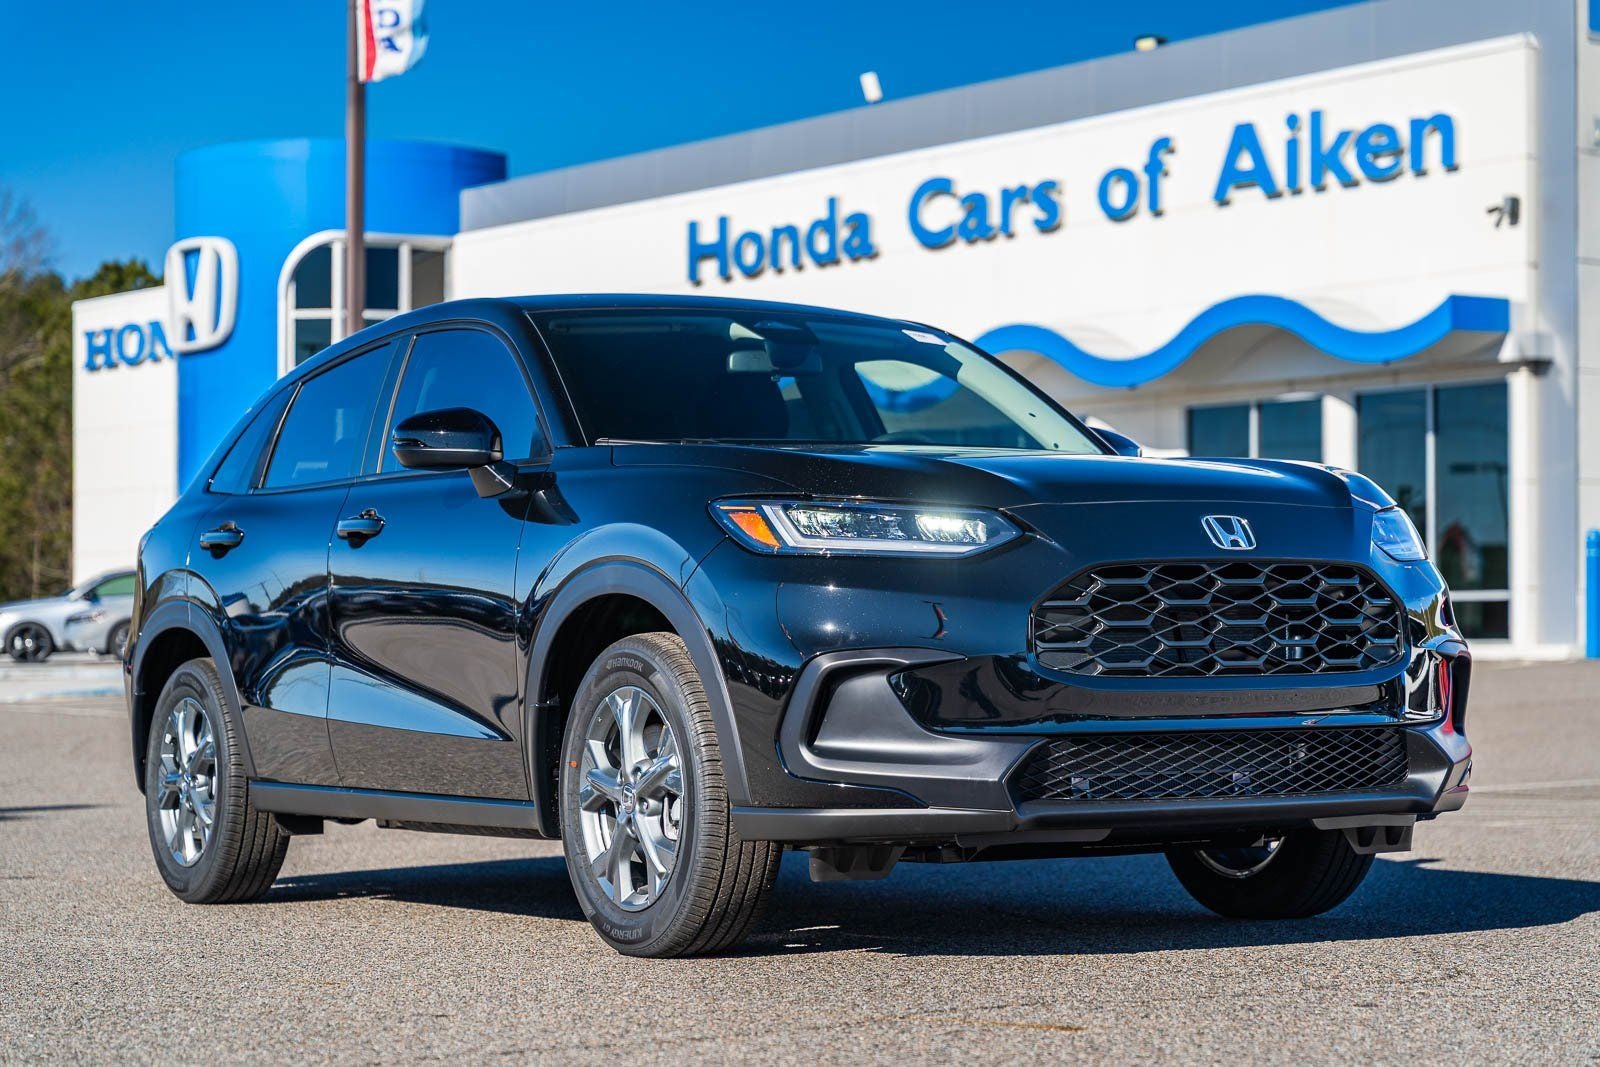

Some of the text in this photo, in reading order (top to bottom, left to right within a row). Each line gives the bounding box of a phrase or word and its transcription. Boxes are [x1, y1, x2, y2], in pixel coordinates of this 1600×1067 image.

[687, 110, 1461, 286] Honda Cars of Aiken
